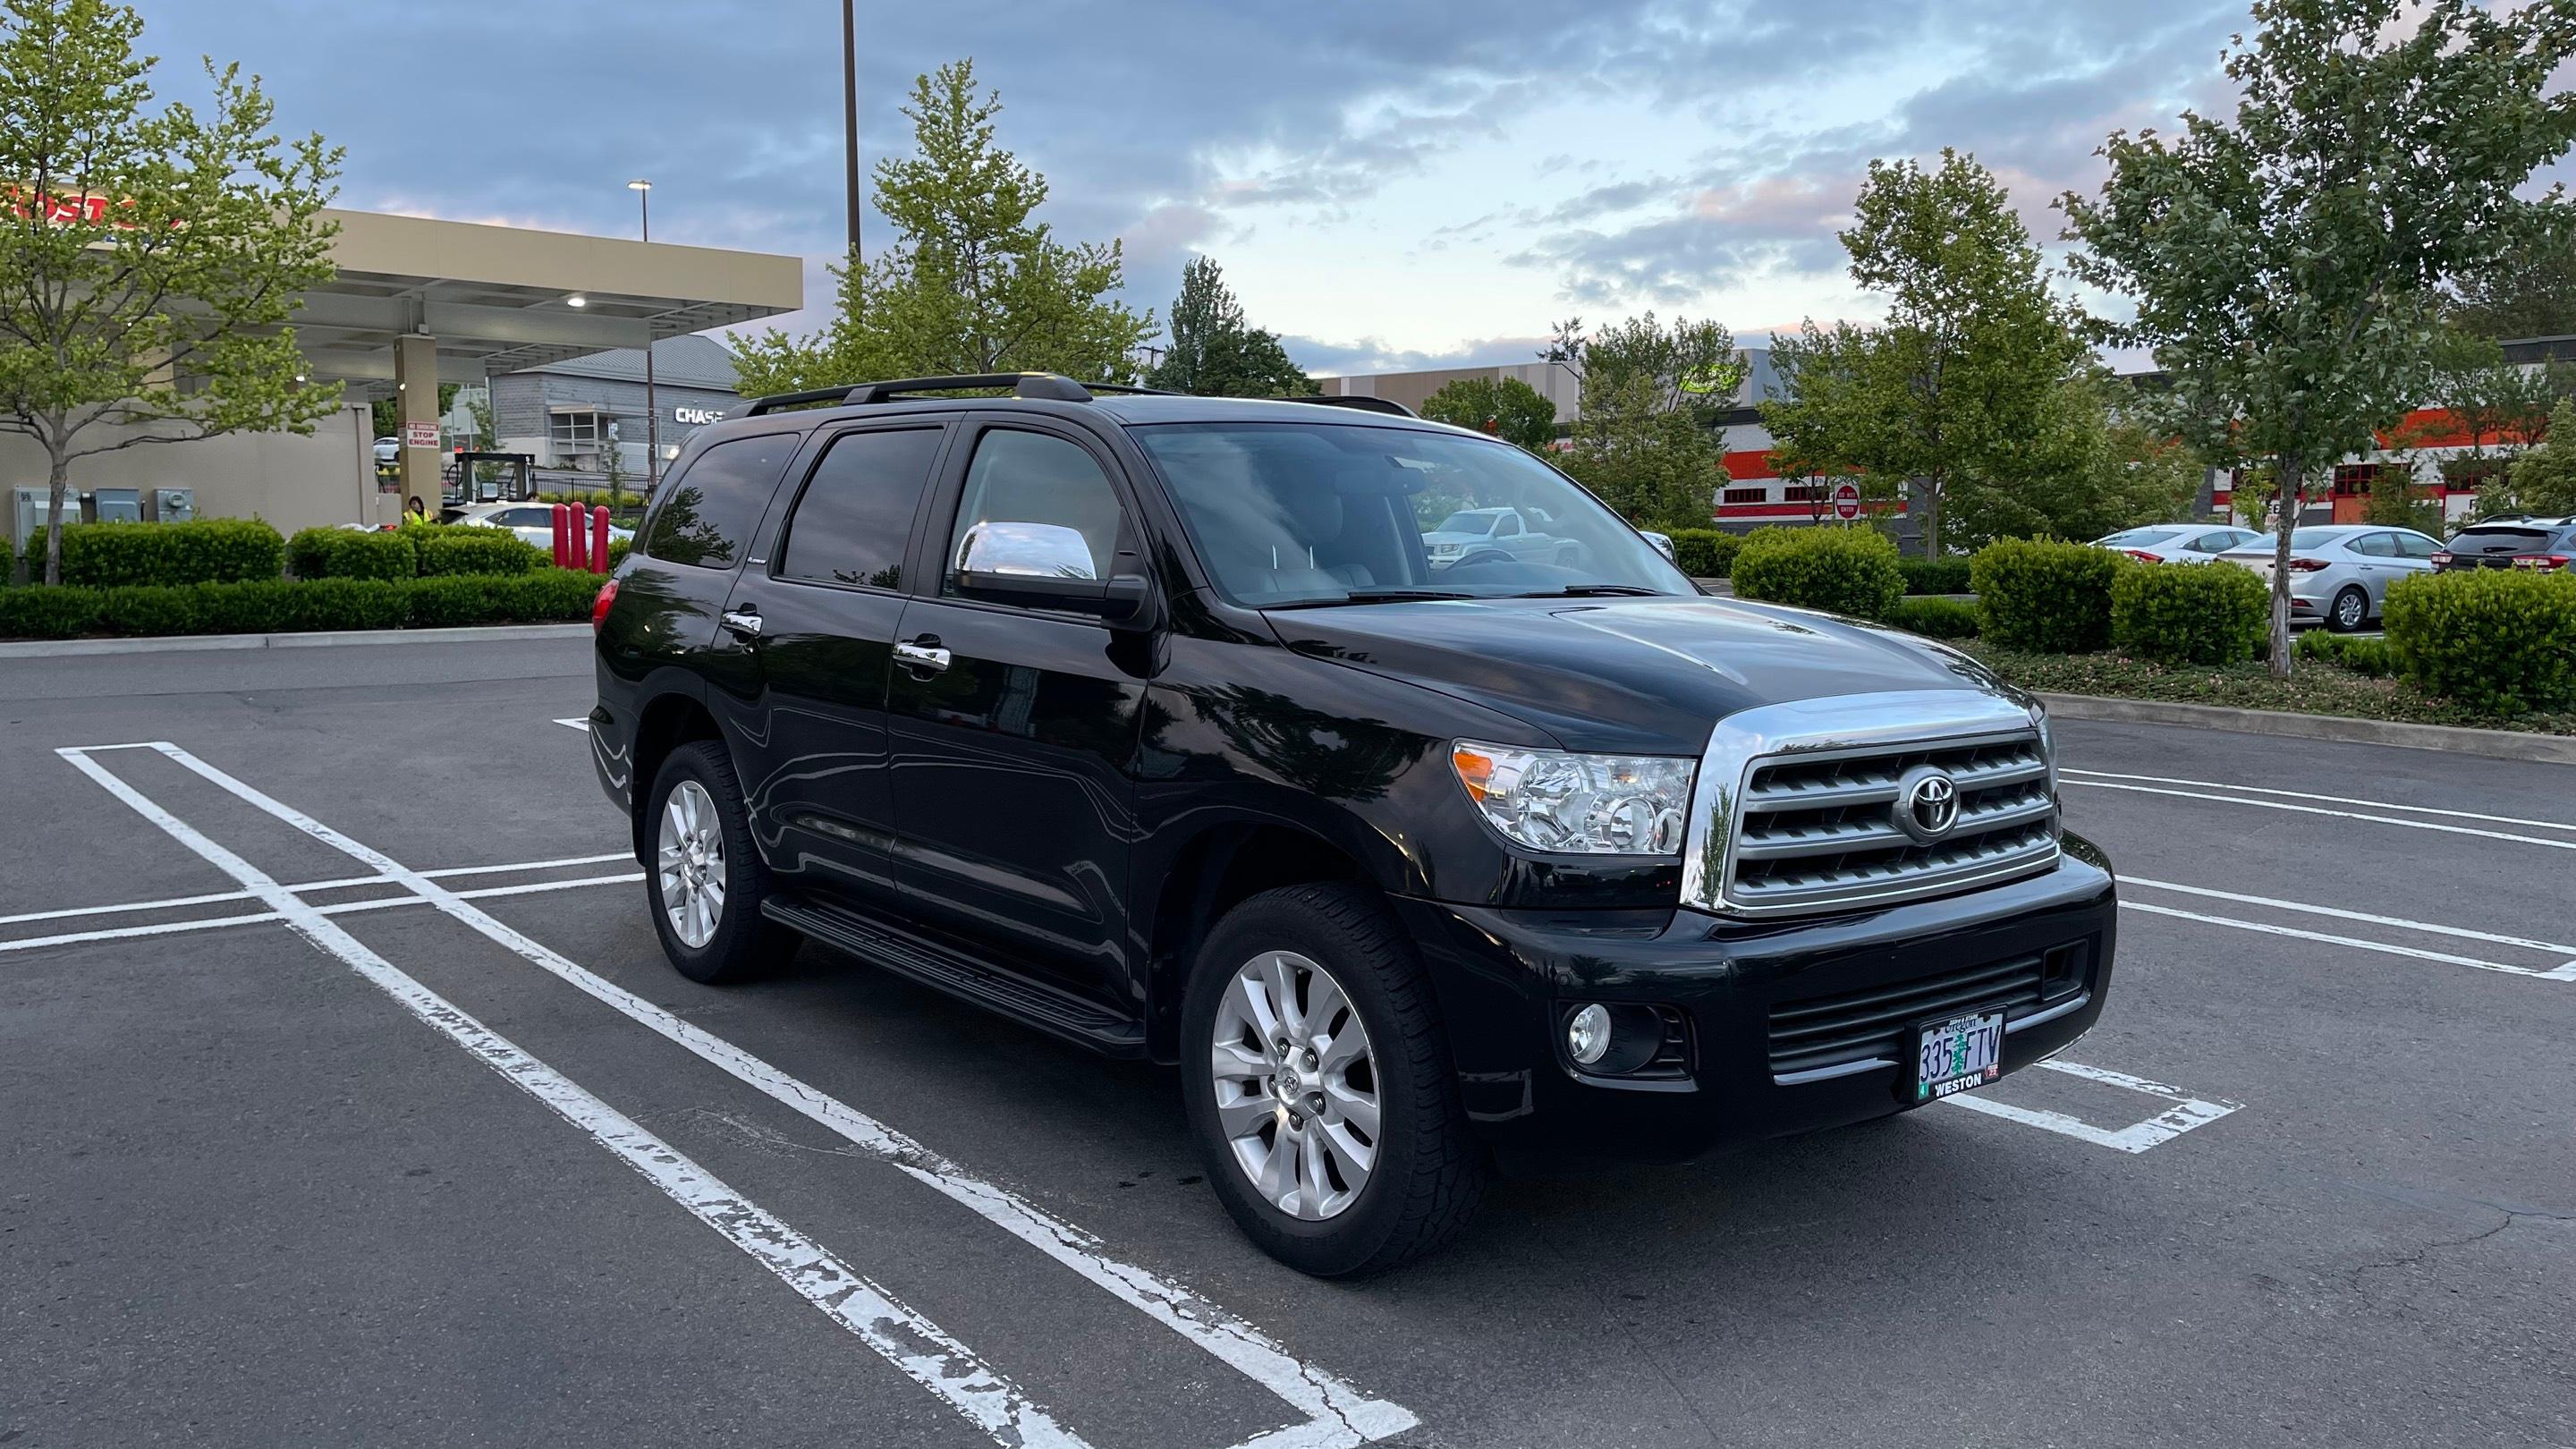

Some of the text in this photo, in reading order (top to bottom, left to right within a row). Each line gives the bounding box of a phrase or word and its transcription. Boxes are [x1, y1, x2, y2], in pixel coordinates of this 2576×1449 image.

[674, 407, 724, 425] CHASE
[1919, 1024, 2001, 1082] 335 FTV
[1935, 1072, 1982, 1097] WESTON
